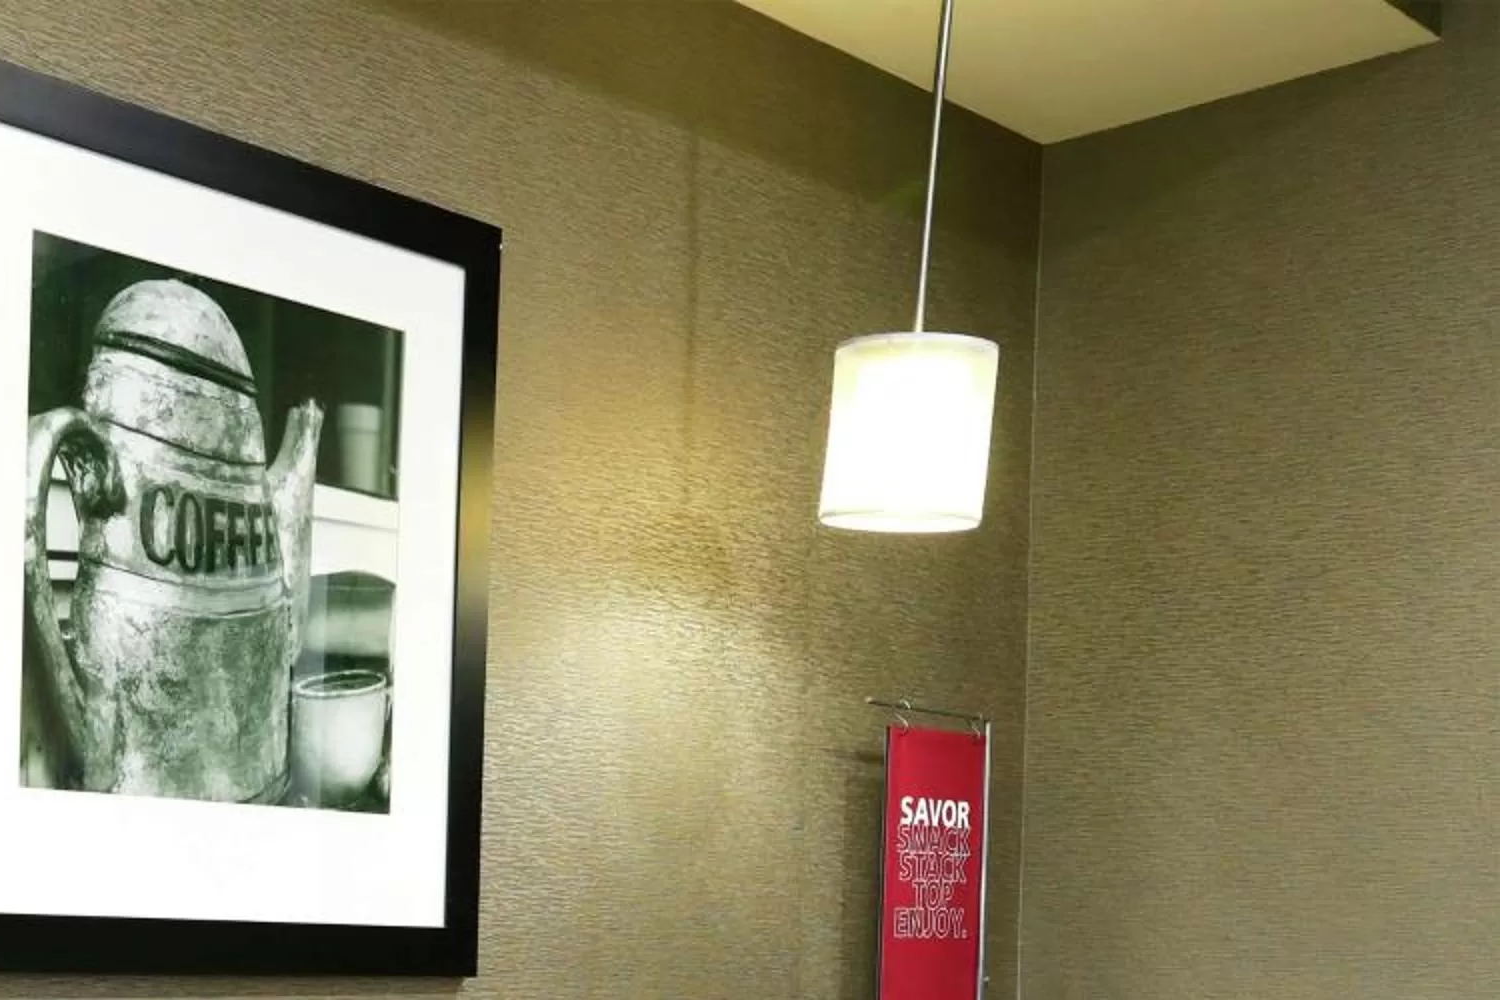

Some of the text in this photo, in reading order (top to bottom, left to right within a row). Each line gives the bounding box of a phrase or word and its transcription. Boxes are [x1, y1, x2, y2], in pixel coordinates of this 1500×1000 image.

[900, 795, 971, 829] SAVOR
[897, 823, 971, 856] SNACK
[899, 850, 967, 883] STACK
[912, 879, 954, 910] TOP
[893, 906, 968, 939] ENJOY.
